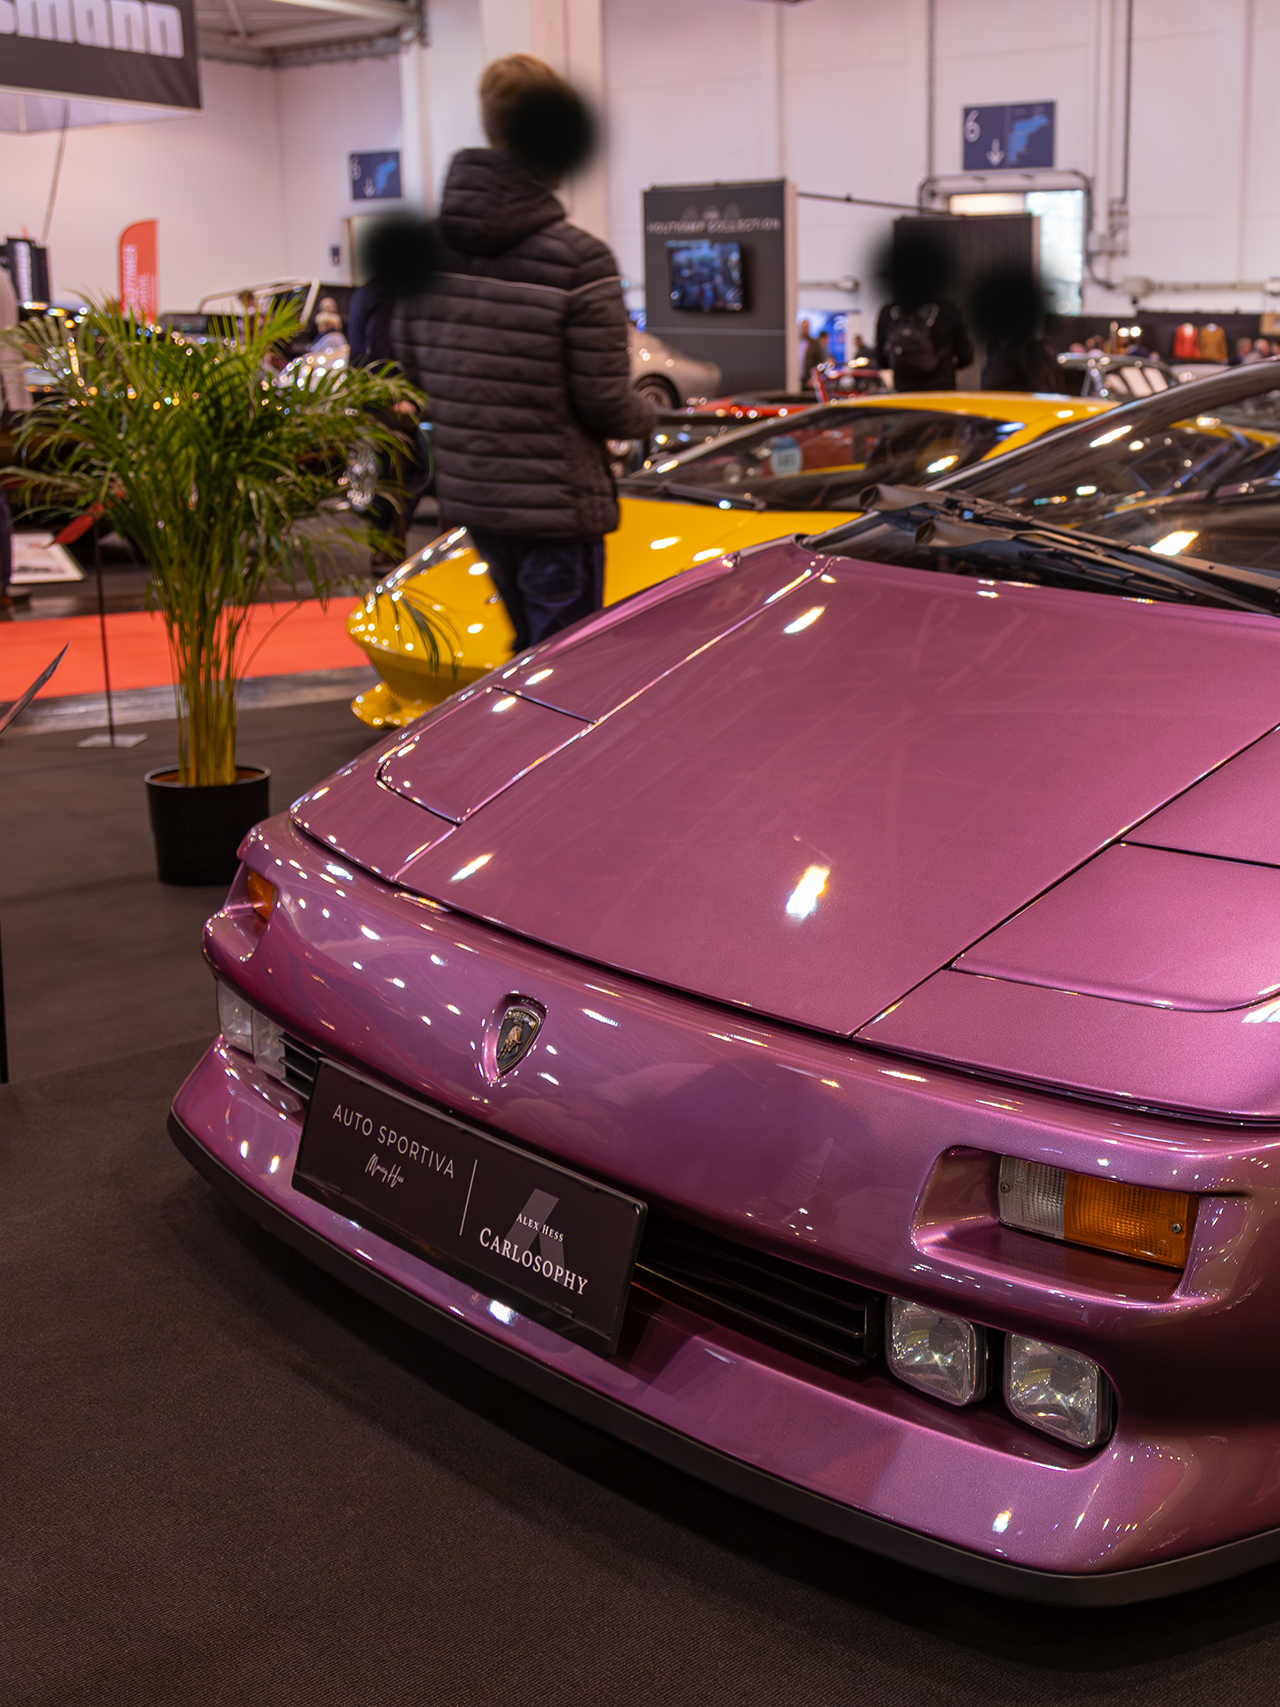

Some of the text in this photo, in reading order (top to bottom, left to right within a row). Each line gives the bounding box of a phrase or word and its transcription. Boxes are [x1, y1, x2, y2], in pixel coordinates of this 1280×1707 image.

[965, 109, 981, 143] 6
[332, 1104, 374, 1137] AUTO
[377, 1126, 455, 1180] SPORTIVA
[516, 1212, 565, 1243] ALEX HESS
[479, 1227, 589, 1296] CARLOSOPHY
